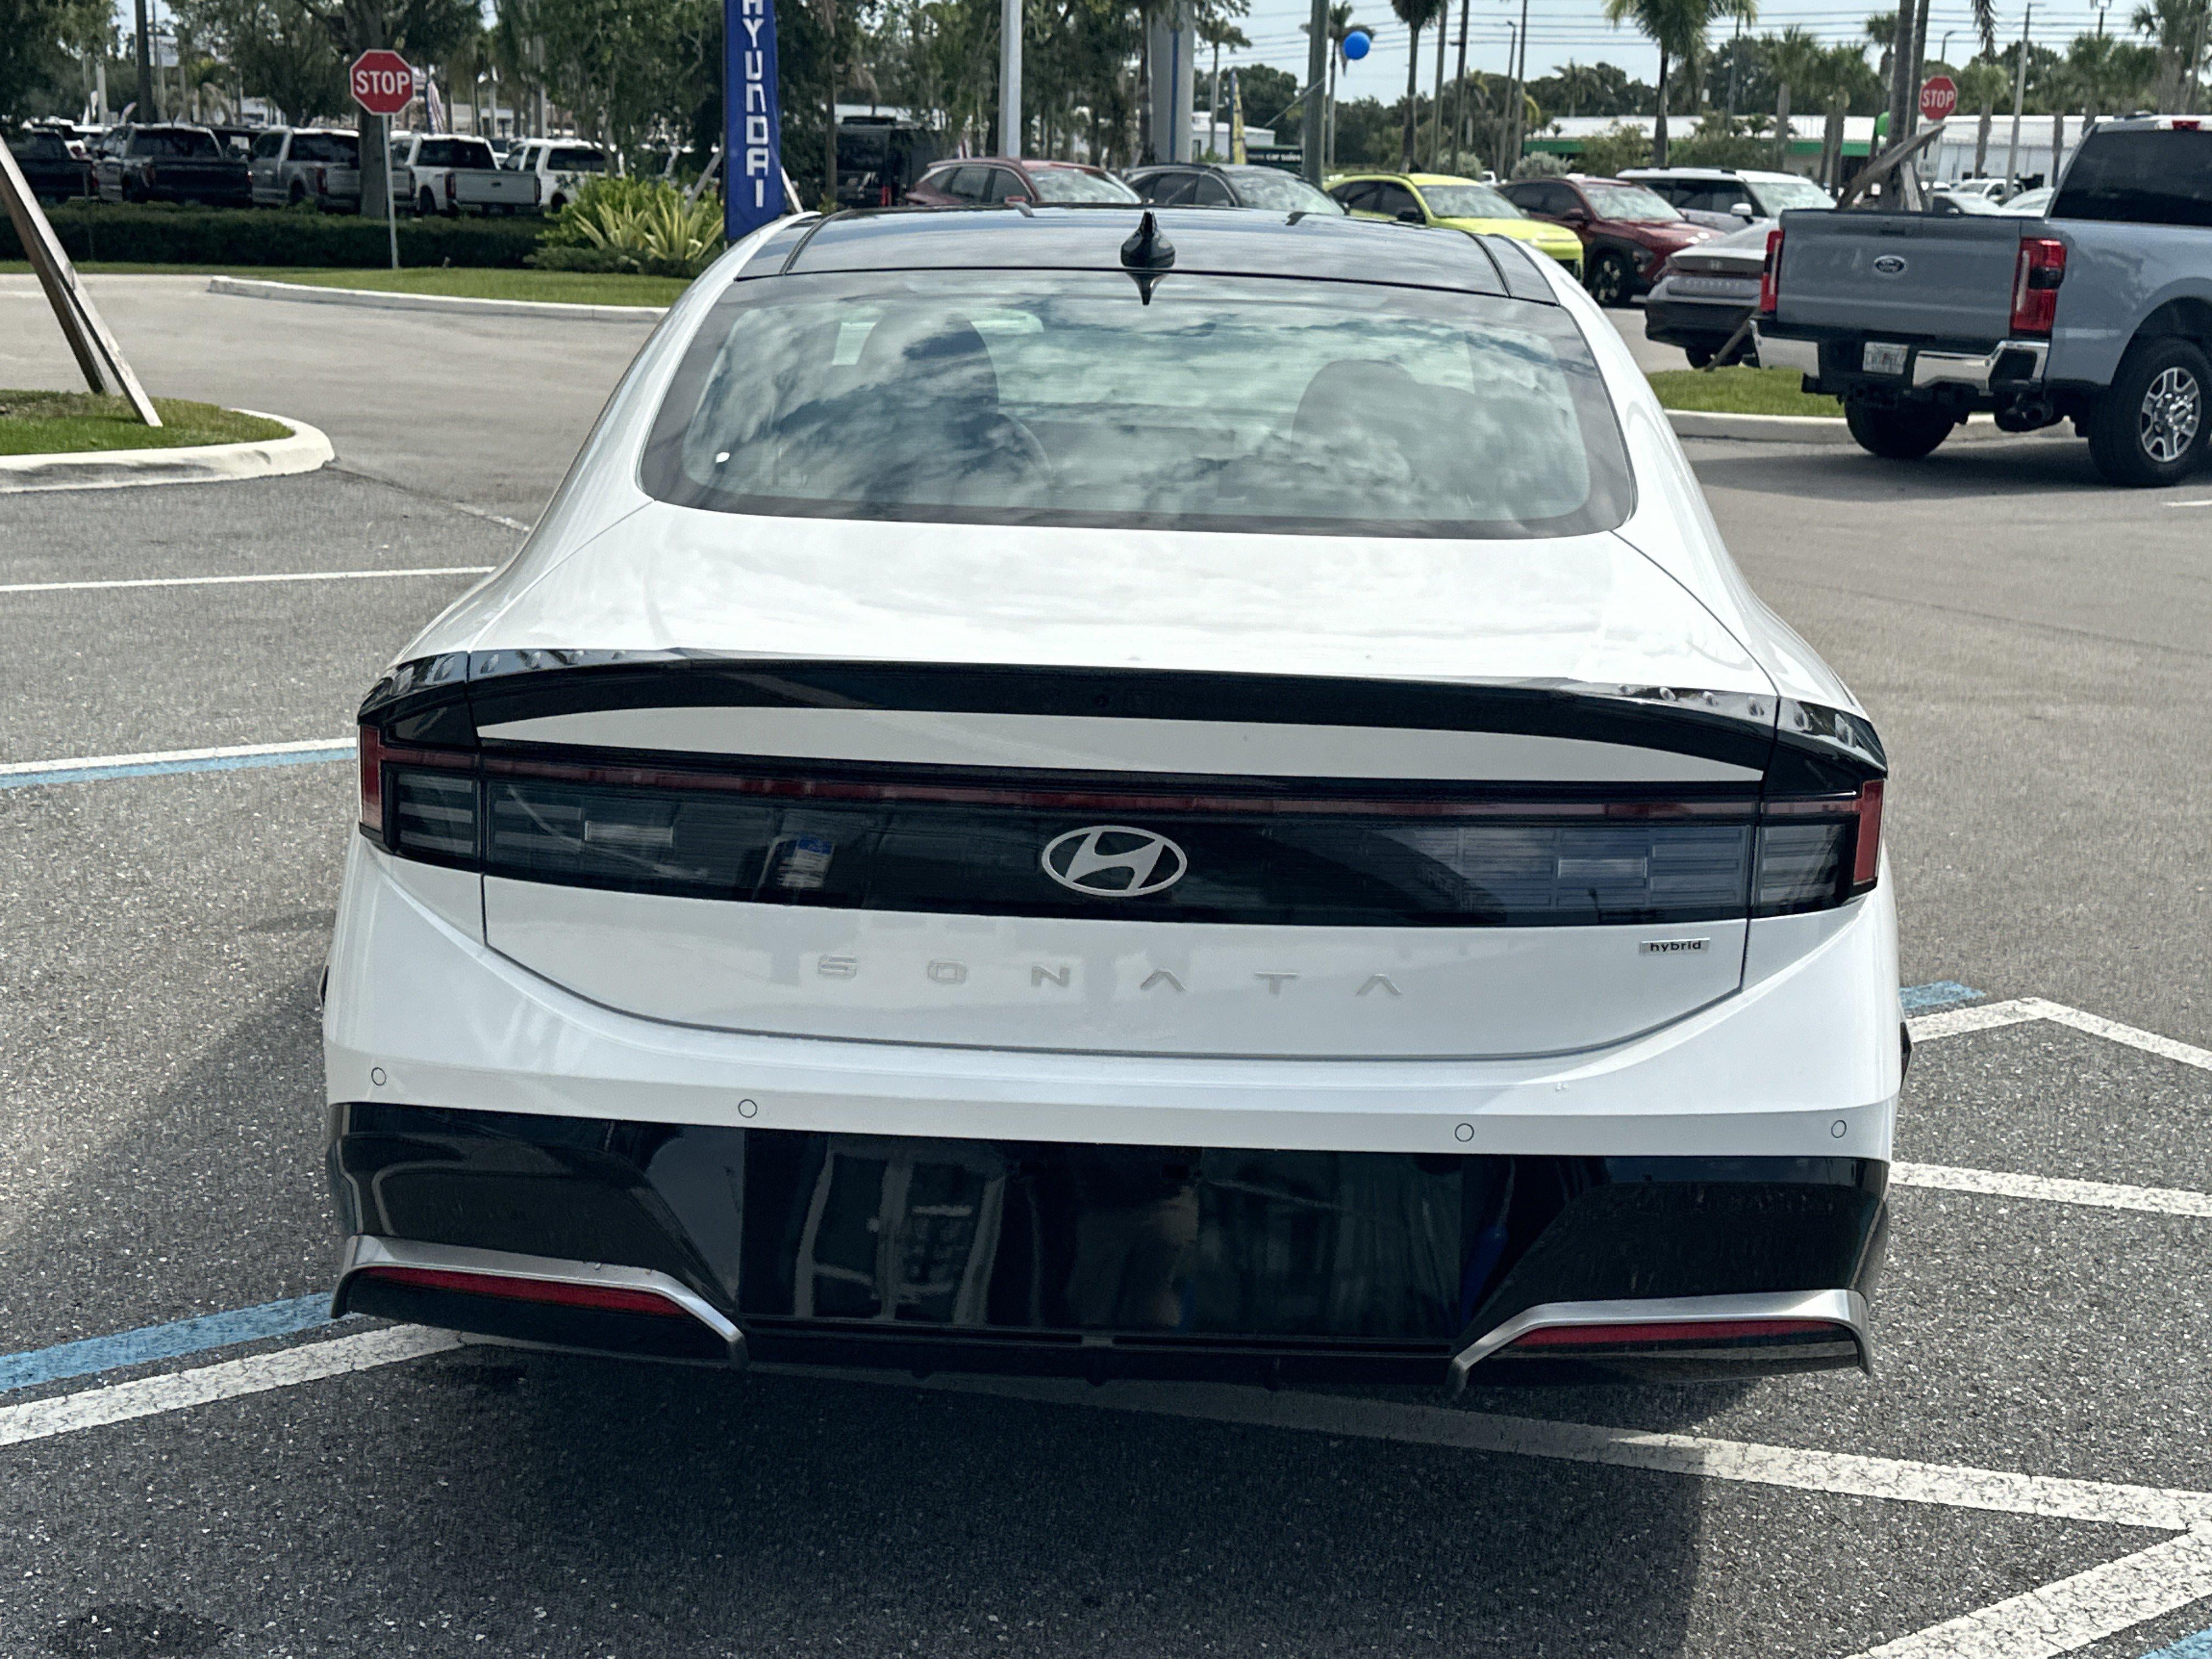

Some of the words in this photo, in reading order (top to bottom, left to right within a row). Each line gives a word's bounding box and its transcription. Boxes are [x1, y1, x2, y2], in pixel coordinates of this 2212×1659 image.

[356, 70, 410, 94] STOP
[1922, 89, 1954, 108] STOP
[1650, 940, 1701, 952] hybrid
[817, 955, 1402, 996] SONATA
